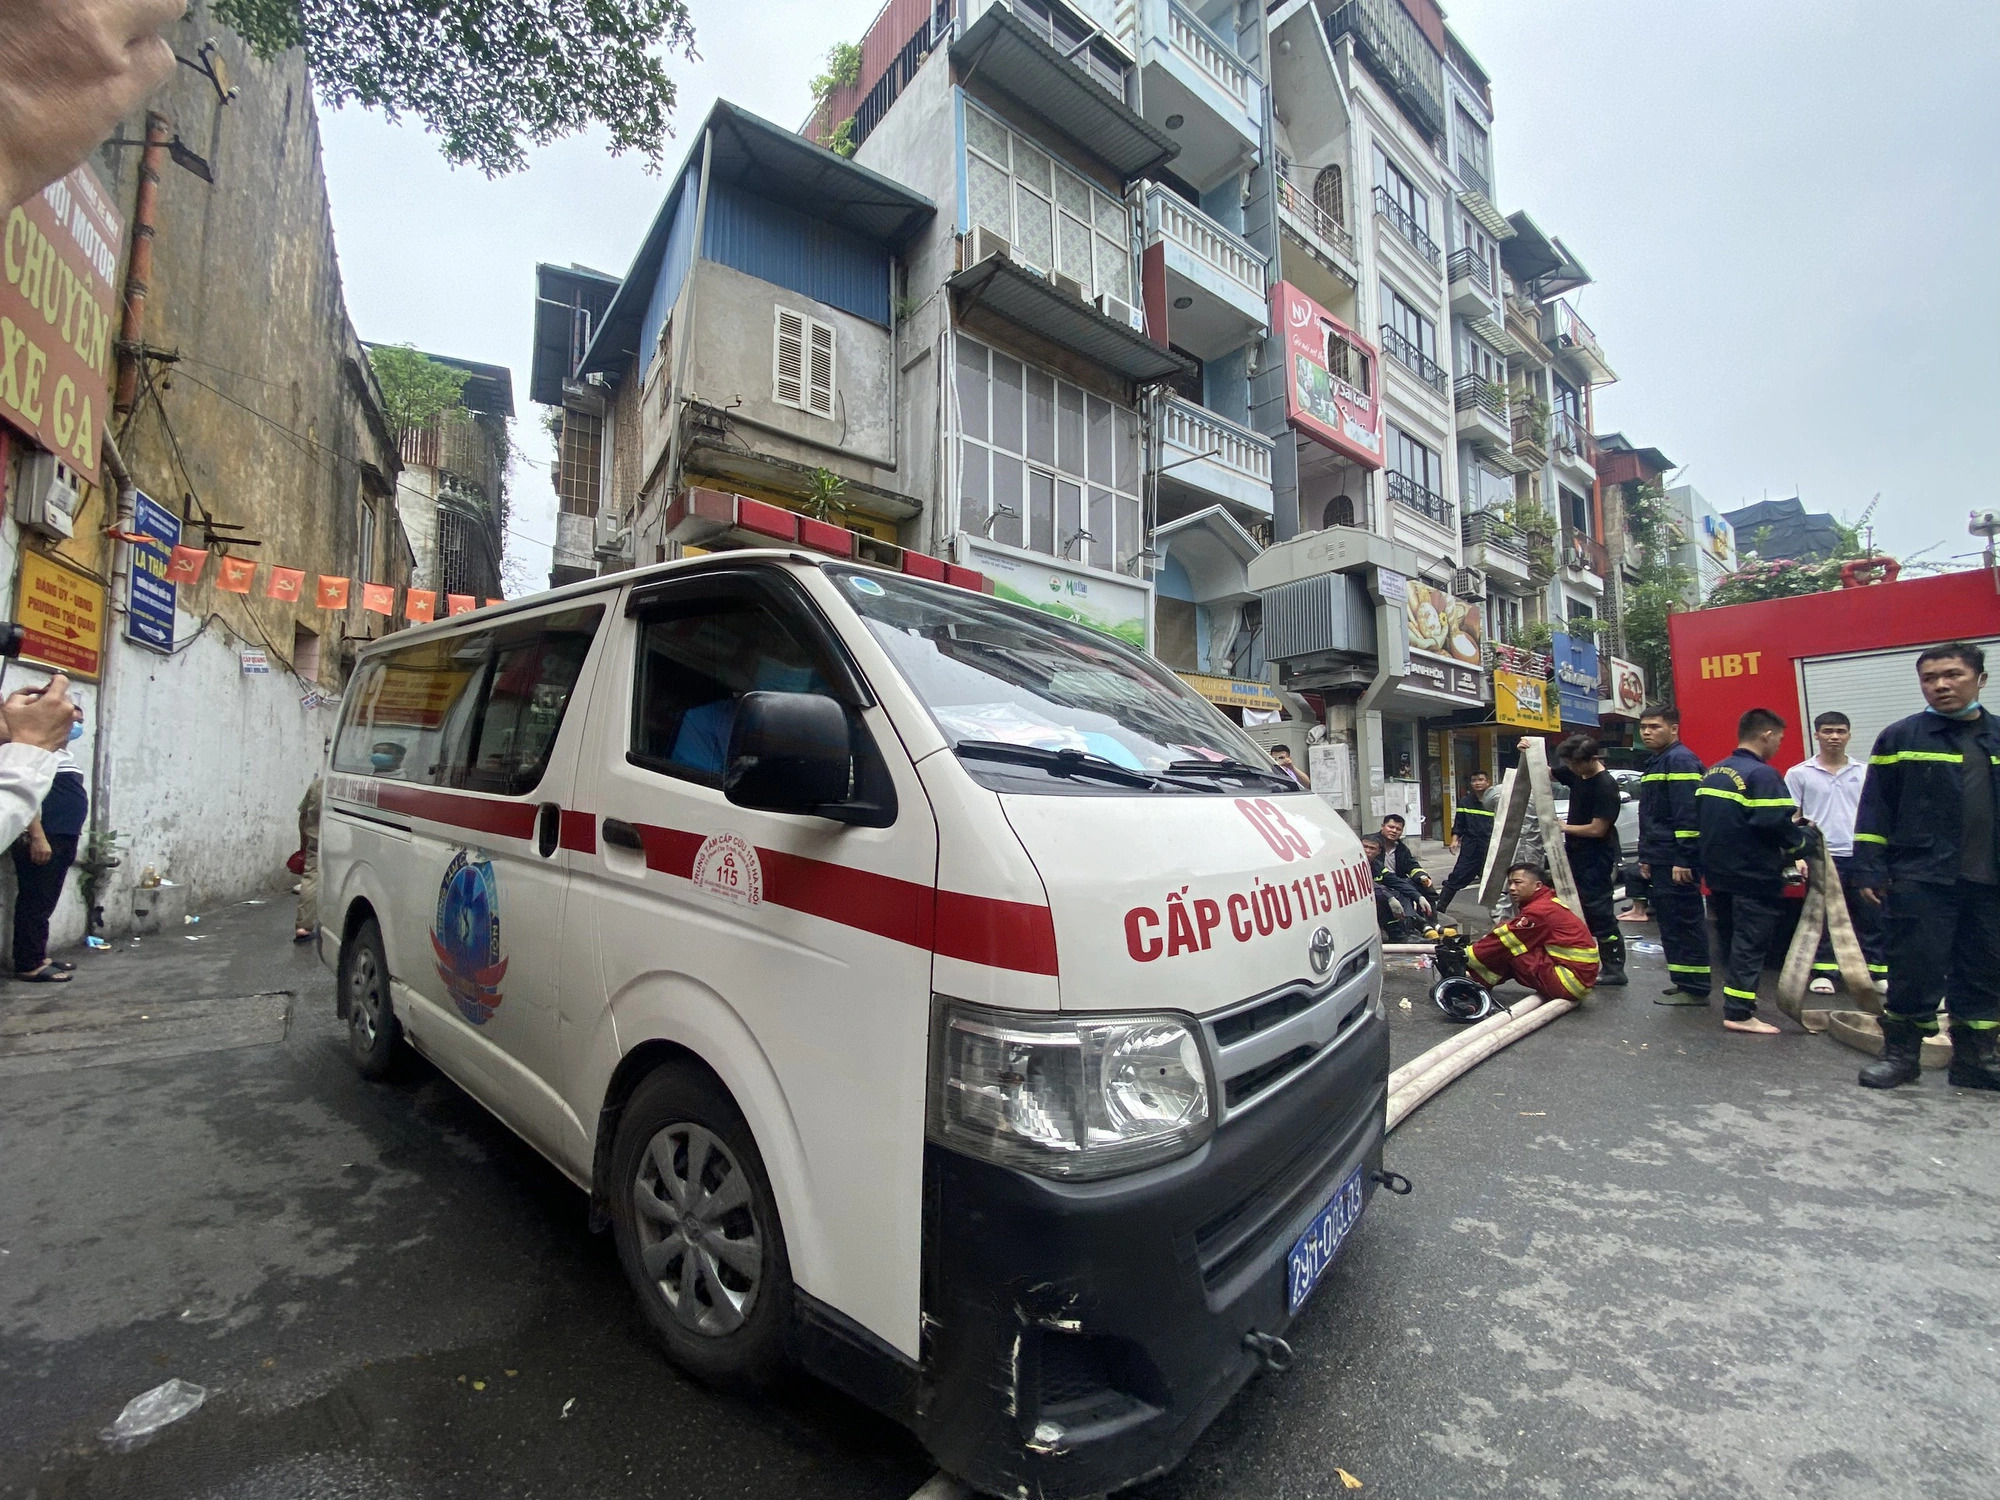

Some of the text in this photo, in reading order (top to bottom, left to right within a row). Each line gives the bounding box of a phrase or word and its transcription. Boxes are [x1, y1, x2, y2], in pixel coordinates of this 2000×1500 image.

[72, 202, 116, 290] MOTOR
[4, 204, 109, 378] CHUYÊN
[0, 316, 94, 471] XE GA
[135, 547, 147, 570] LA
[1700, 651, 1762, 680] HBT
[693, 853, 706, 885] TRUNG
[704, 837, 718, 853] TÂM
[719, 833, 733, 844] CẤP
[1234, 798, 1313, 862] 03
[716, 865, 738, 886] 115
[1123, 885, 1221, 963] CẤP
[1227, 876, 1293, 943] CỨU
[1292, 873, 1332, 921] 115
[1331, 859, 1359, 908] HÀ
